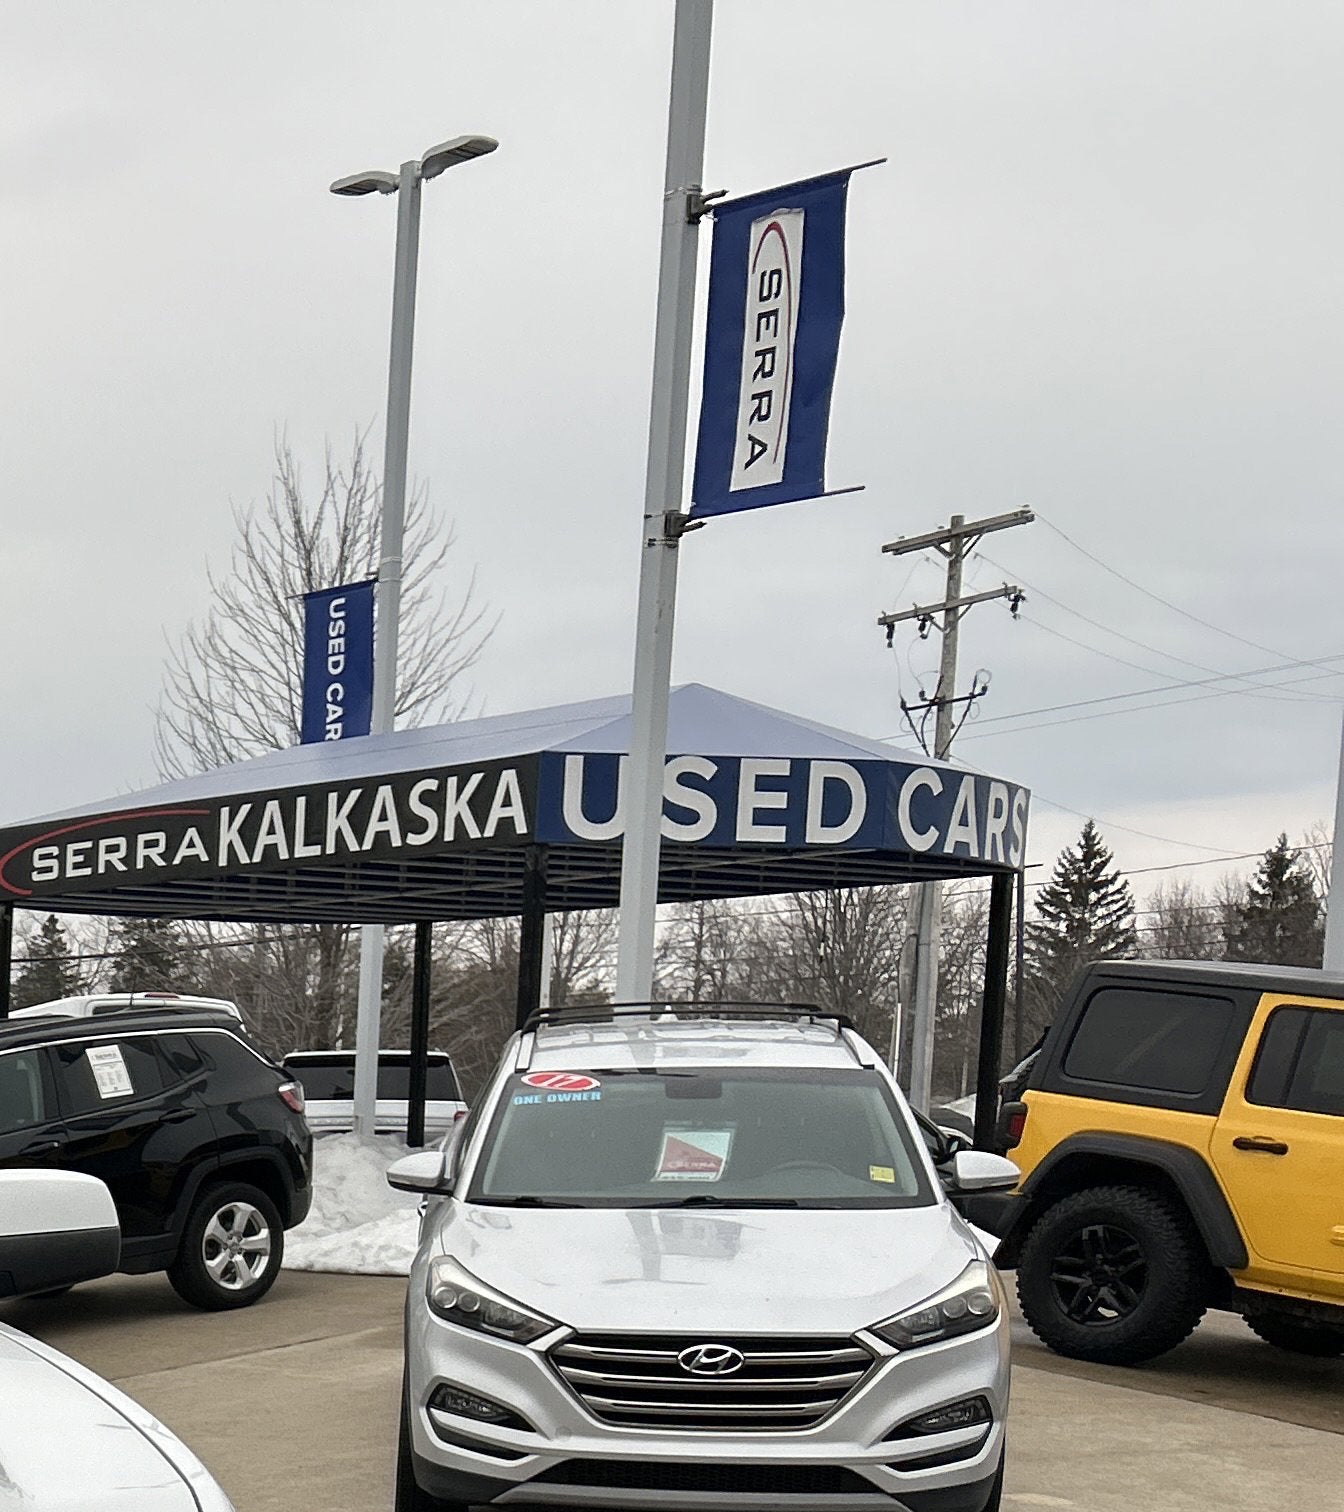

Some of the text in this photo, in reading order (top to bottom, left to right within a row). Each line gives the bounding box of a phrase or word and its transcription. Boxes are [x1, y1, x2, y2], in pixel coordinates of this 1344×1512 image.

[744, 268, 783, 470] SERRA
[324, 597, 346, 741] USED CAR
[31, 768, 529, 882] SERRA KALKASKA
[562, 753, 1028, 868] USED CARS
[547, 1091, 602, 1103] OWNER
